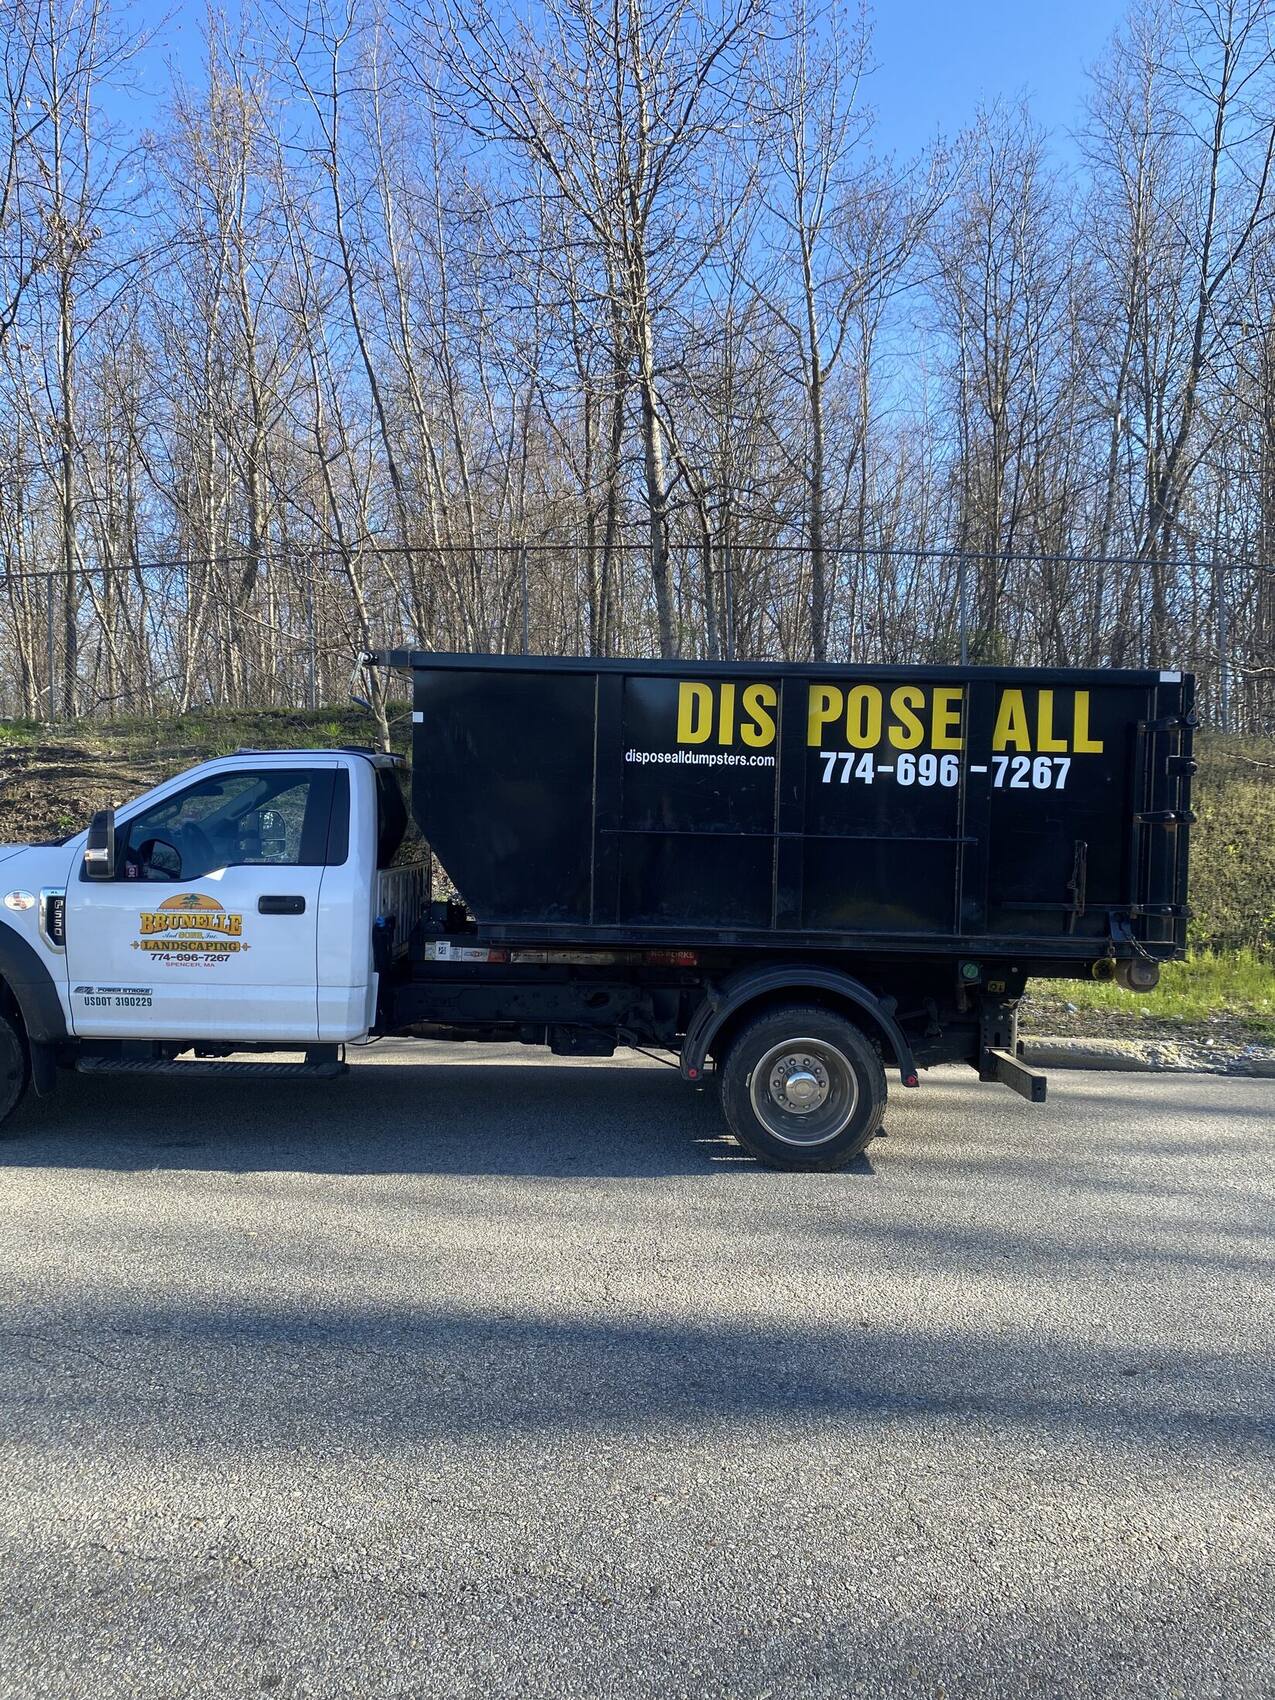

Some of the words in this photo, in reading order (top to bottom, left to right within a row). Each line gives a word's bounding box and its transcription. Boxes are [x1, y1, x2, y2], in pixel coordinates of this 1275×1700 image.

[677, 682, 777, 748] DIS
[807, 685, 964, 751] POSE
[992, 689, 1104, 753] ALL
[625, 749, 775, 767] disposealldumpsters.com
[140, 912, 243, 936] BRUNELLE
[144, 941, 237, 951] LANDSCAPING
[150, 953, 230, 962] 774-696-7267
[84, 996, 112, 1006] USDOT
[115, 996, 153, 1007] 3190229
